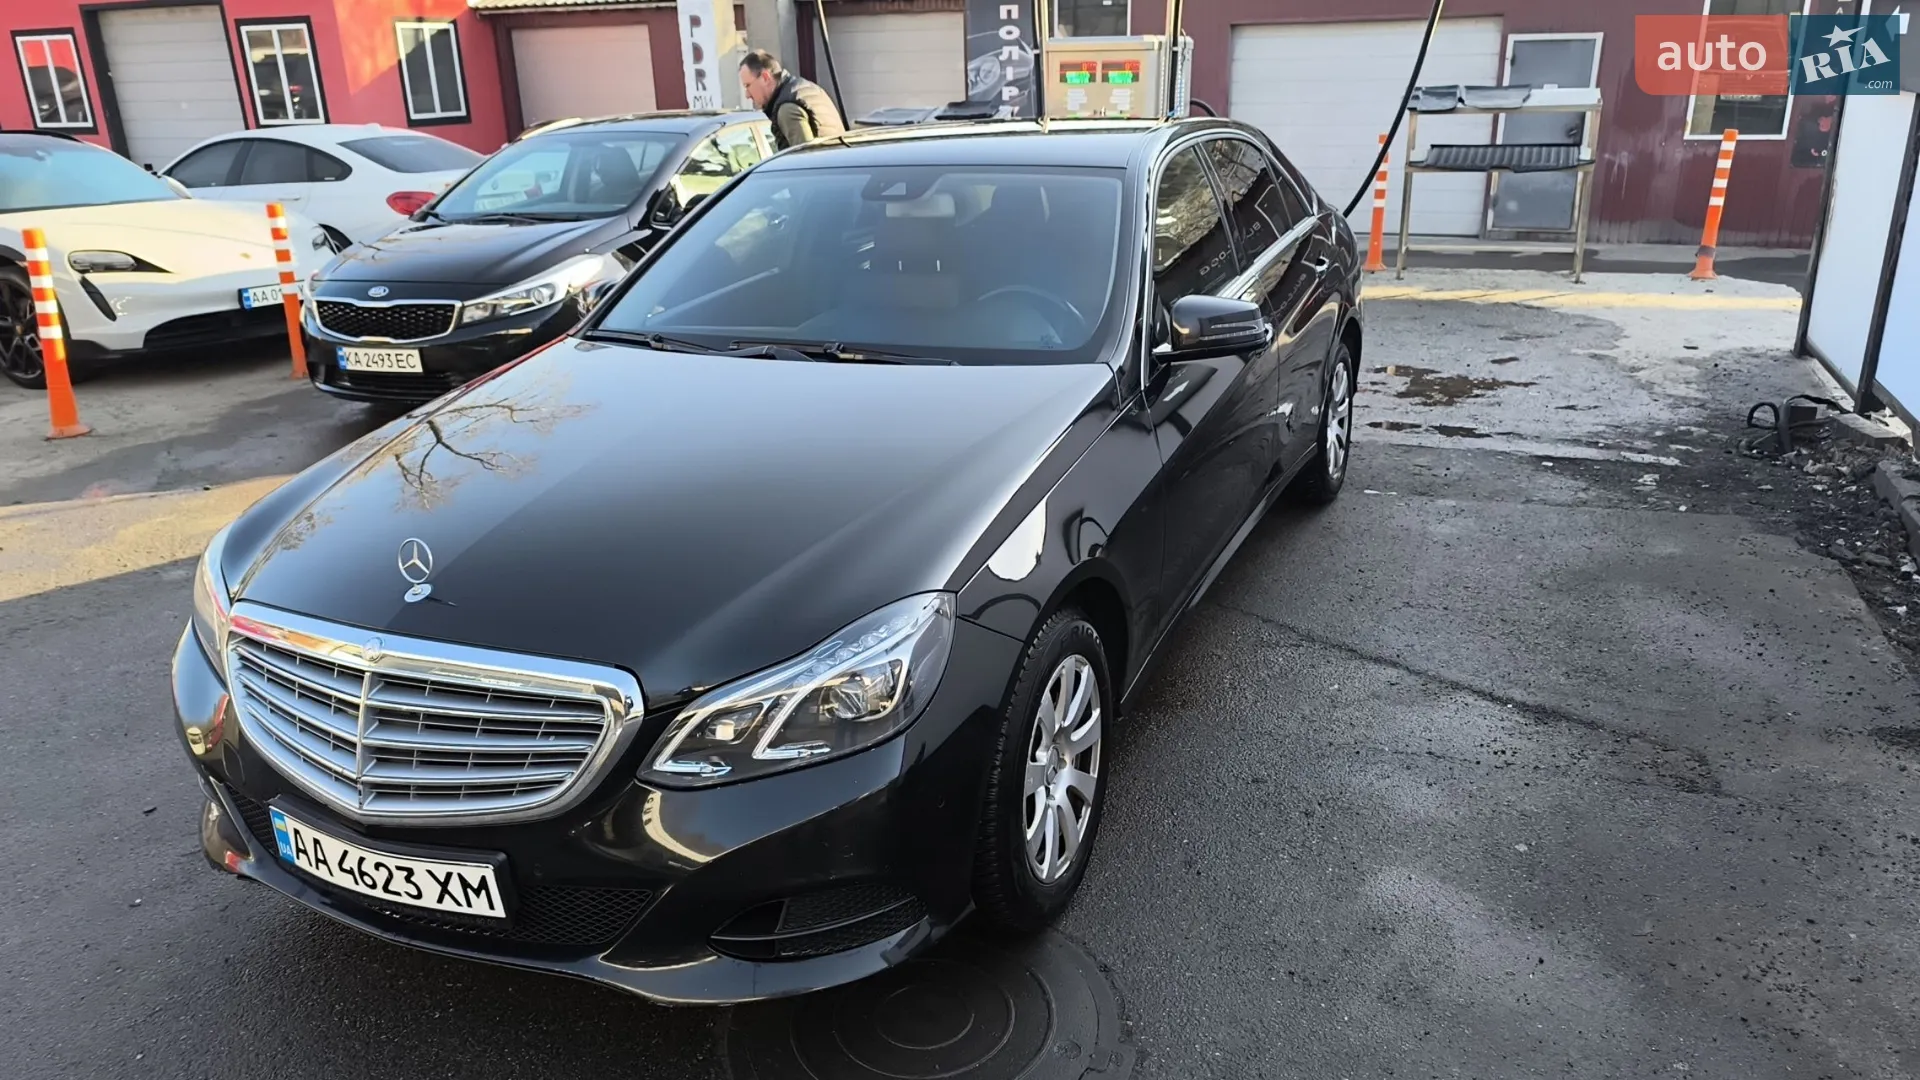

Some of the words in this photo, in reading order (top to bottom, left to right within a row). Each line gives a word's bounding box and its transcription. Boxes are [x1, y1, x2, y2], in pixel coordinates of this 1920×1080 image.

[689, 15, 706, 91] PDR
[252, 290, 268, 303] AA
[345, 352, 362, 366] KA
[364, 353, 393, 368] 2493
[395, 353, 416, 369] EC
[279, 843, 293, 857] UA
[293, 827, 334, 877] AA
[338, 850, 423, 900] 4623
[426, 869, 495, 910] XM
